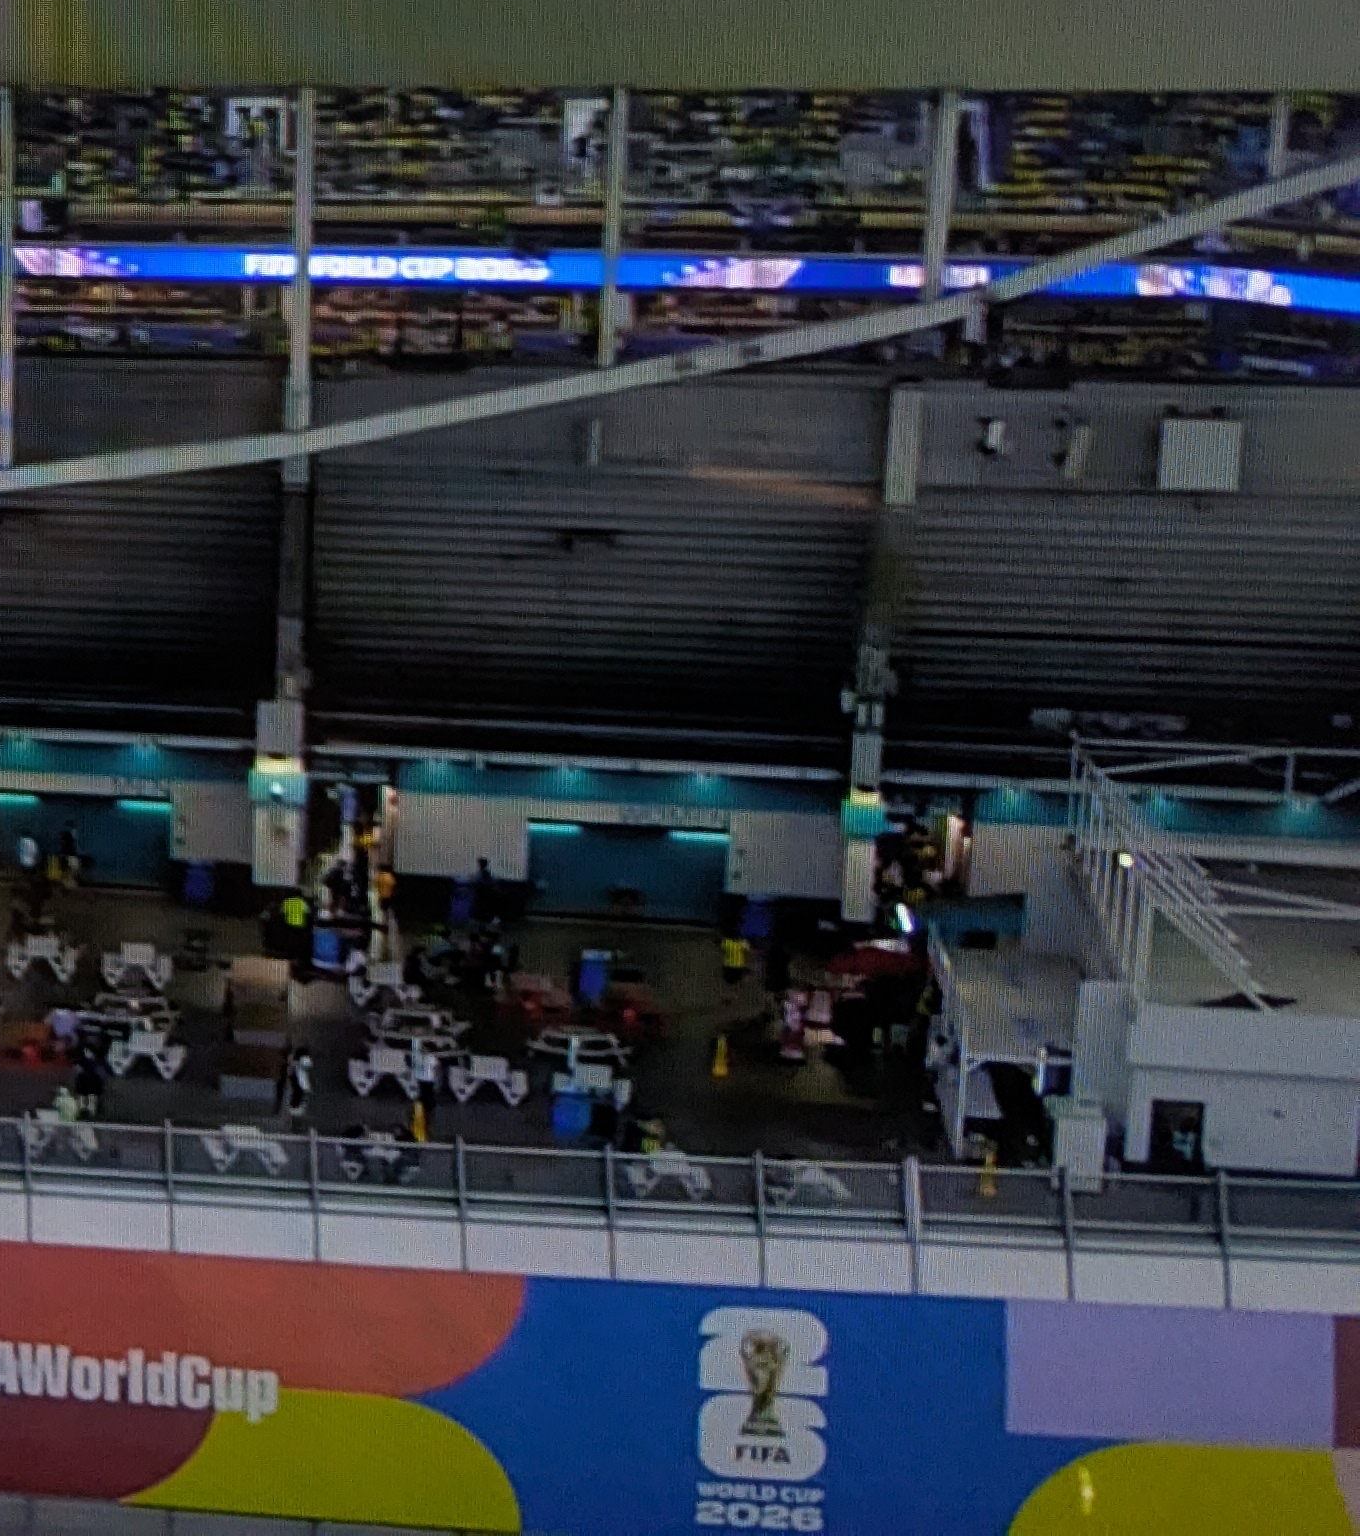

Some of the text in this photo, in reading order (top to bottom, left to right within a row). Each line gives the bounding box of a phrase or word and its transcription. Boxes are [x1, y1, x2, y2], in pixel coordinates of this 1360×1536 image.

[734, 1444, 791, 1464] FIFA
[695, 1481, 826, 1504] WORLD CUP
[694, 1500, 825, 1532] 2026
